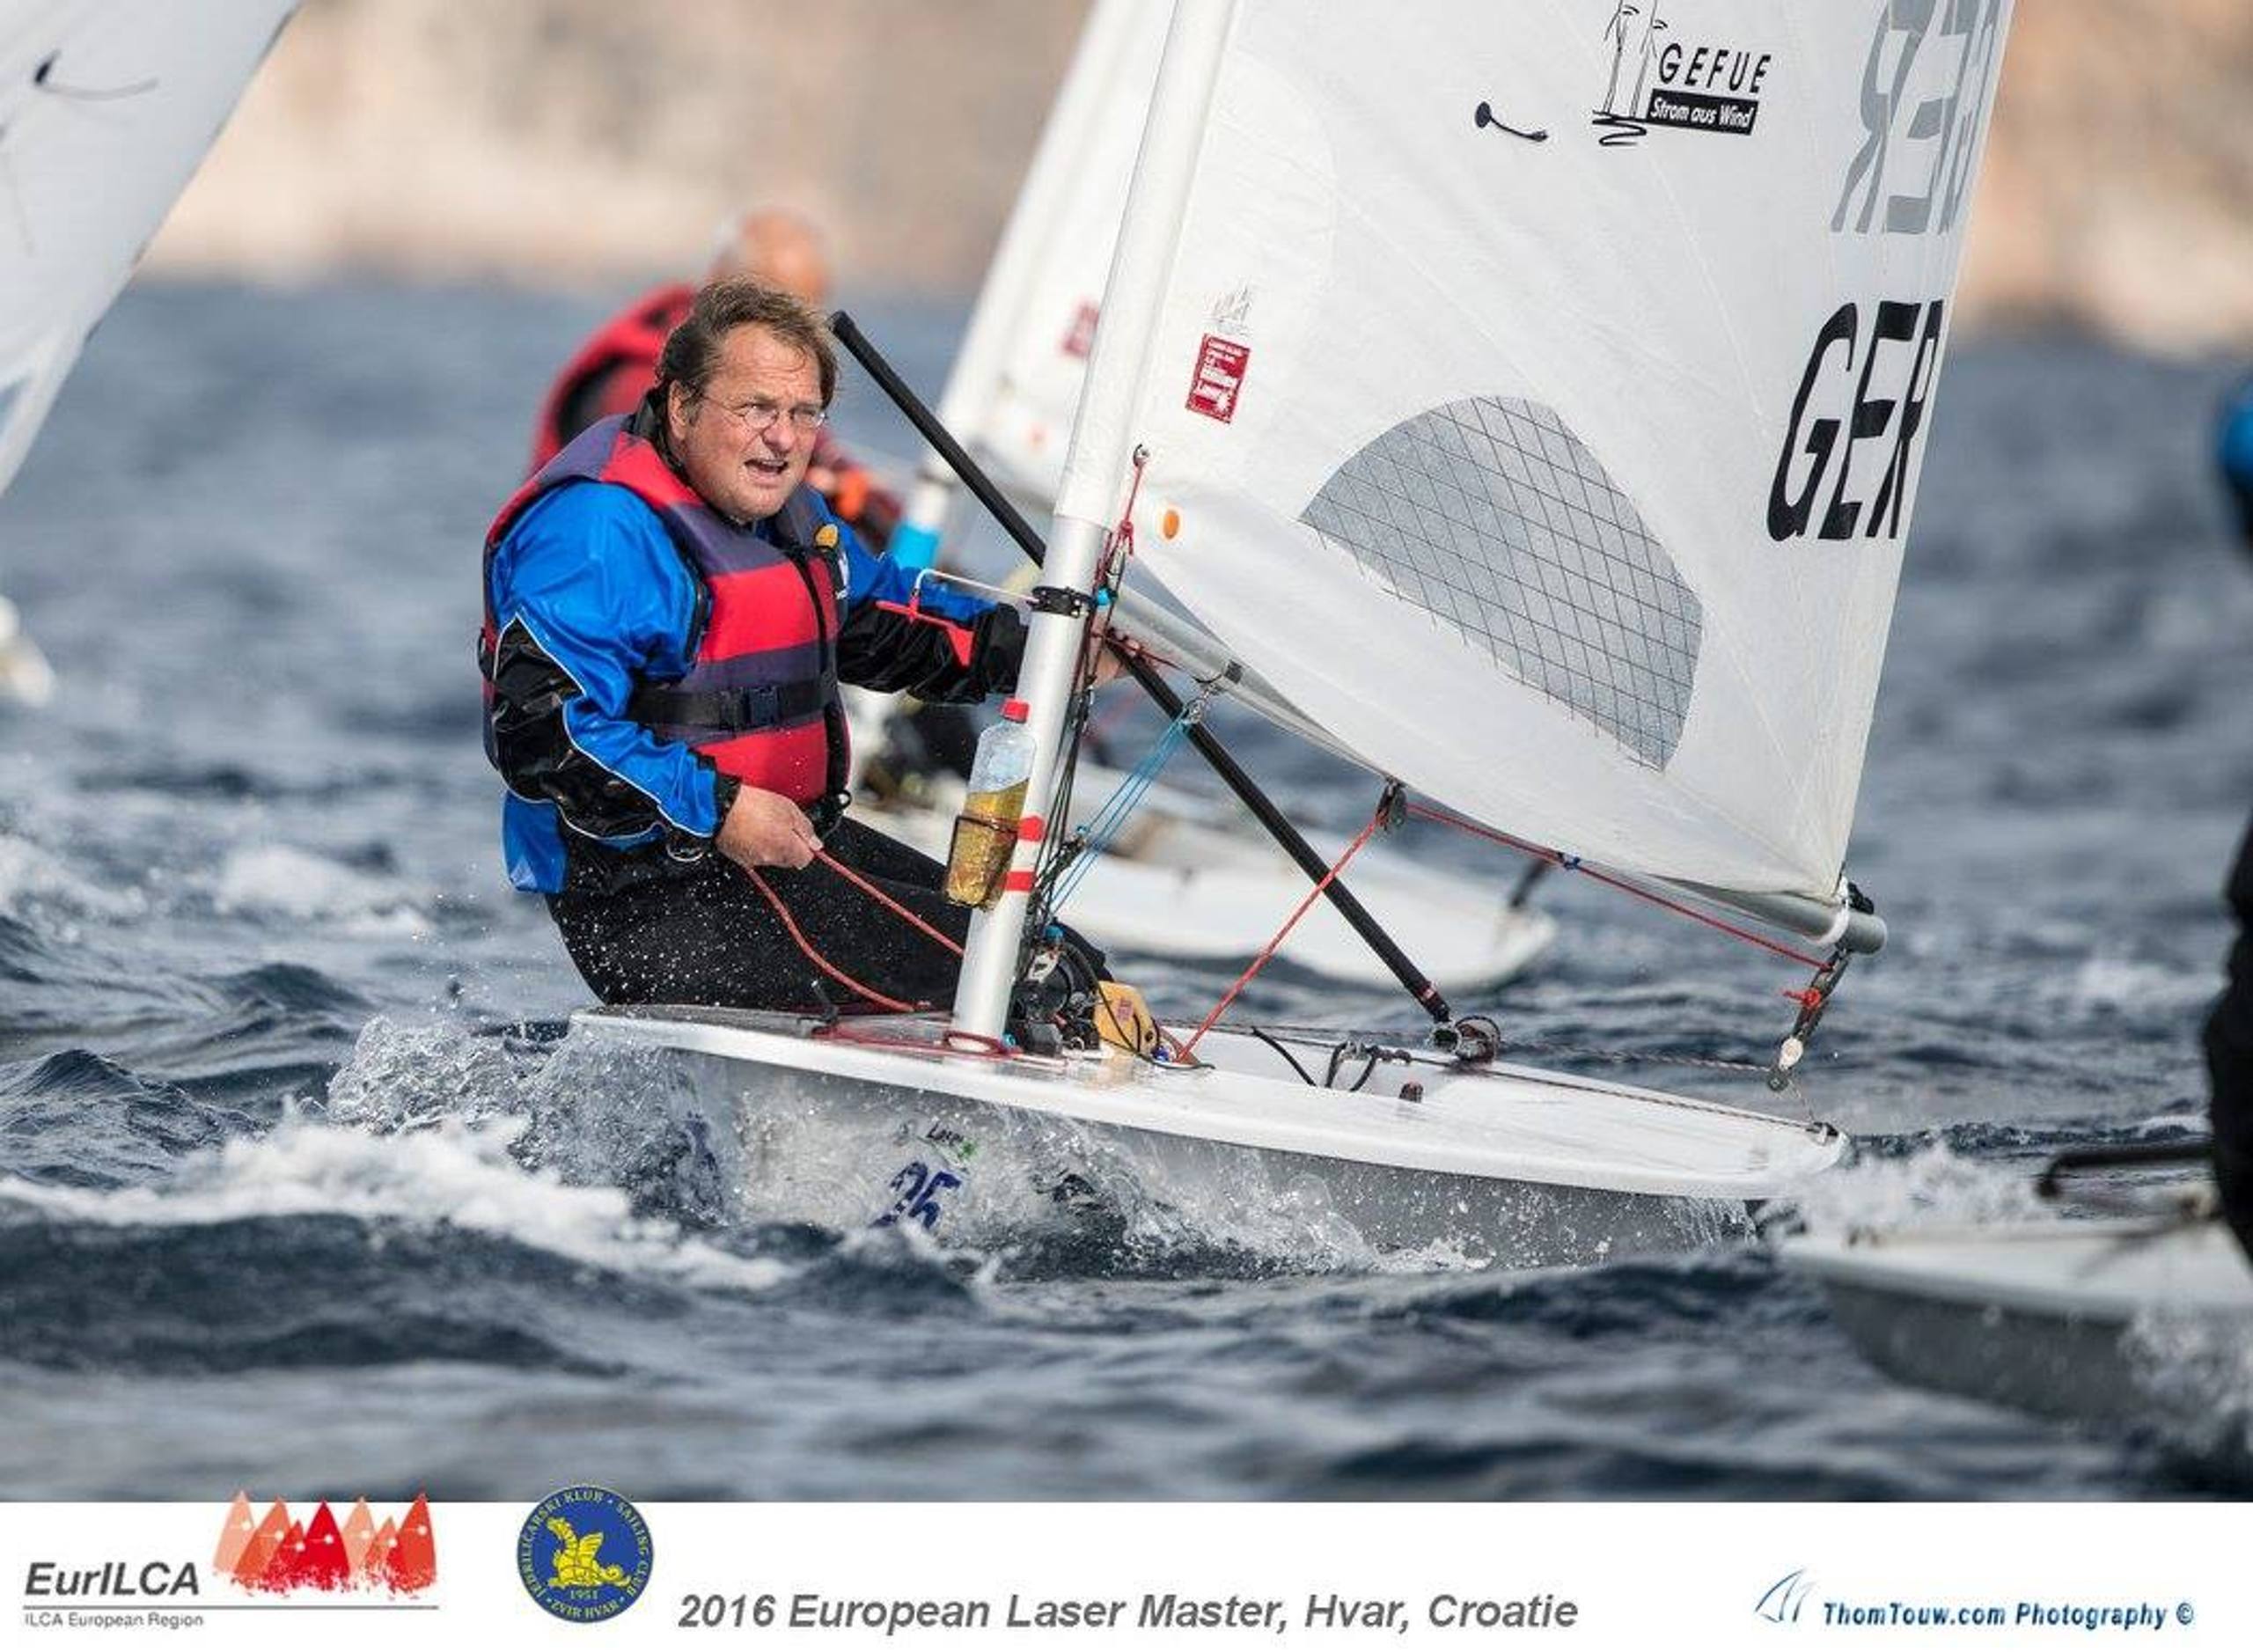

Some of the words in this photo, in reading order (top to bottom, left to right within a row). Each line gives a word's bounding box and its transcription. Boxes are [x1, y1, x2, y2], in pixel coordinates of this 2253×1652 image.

[1659, 43, 1771, 92] GEFUE
[1650, 98, 1690, 121] Strom
[1691, 107, 1717, 124] aus
[1719, 105, 1755, 128] Wind
